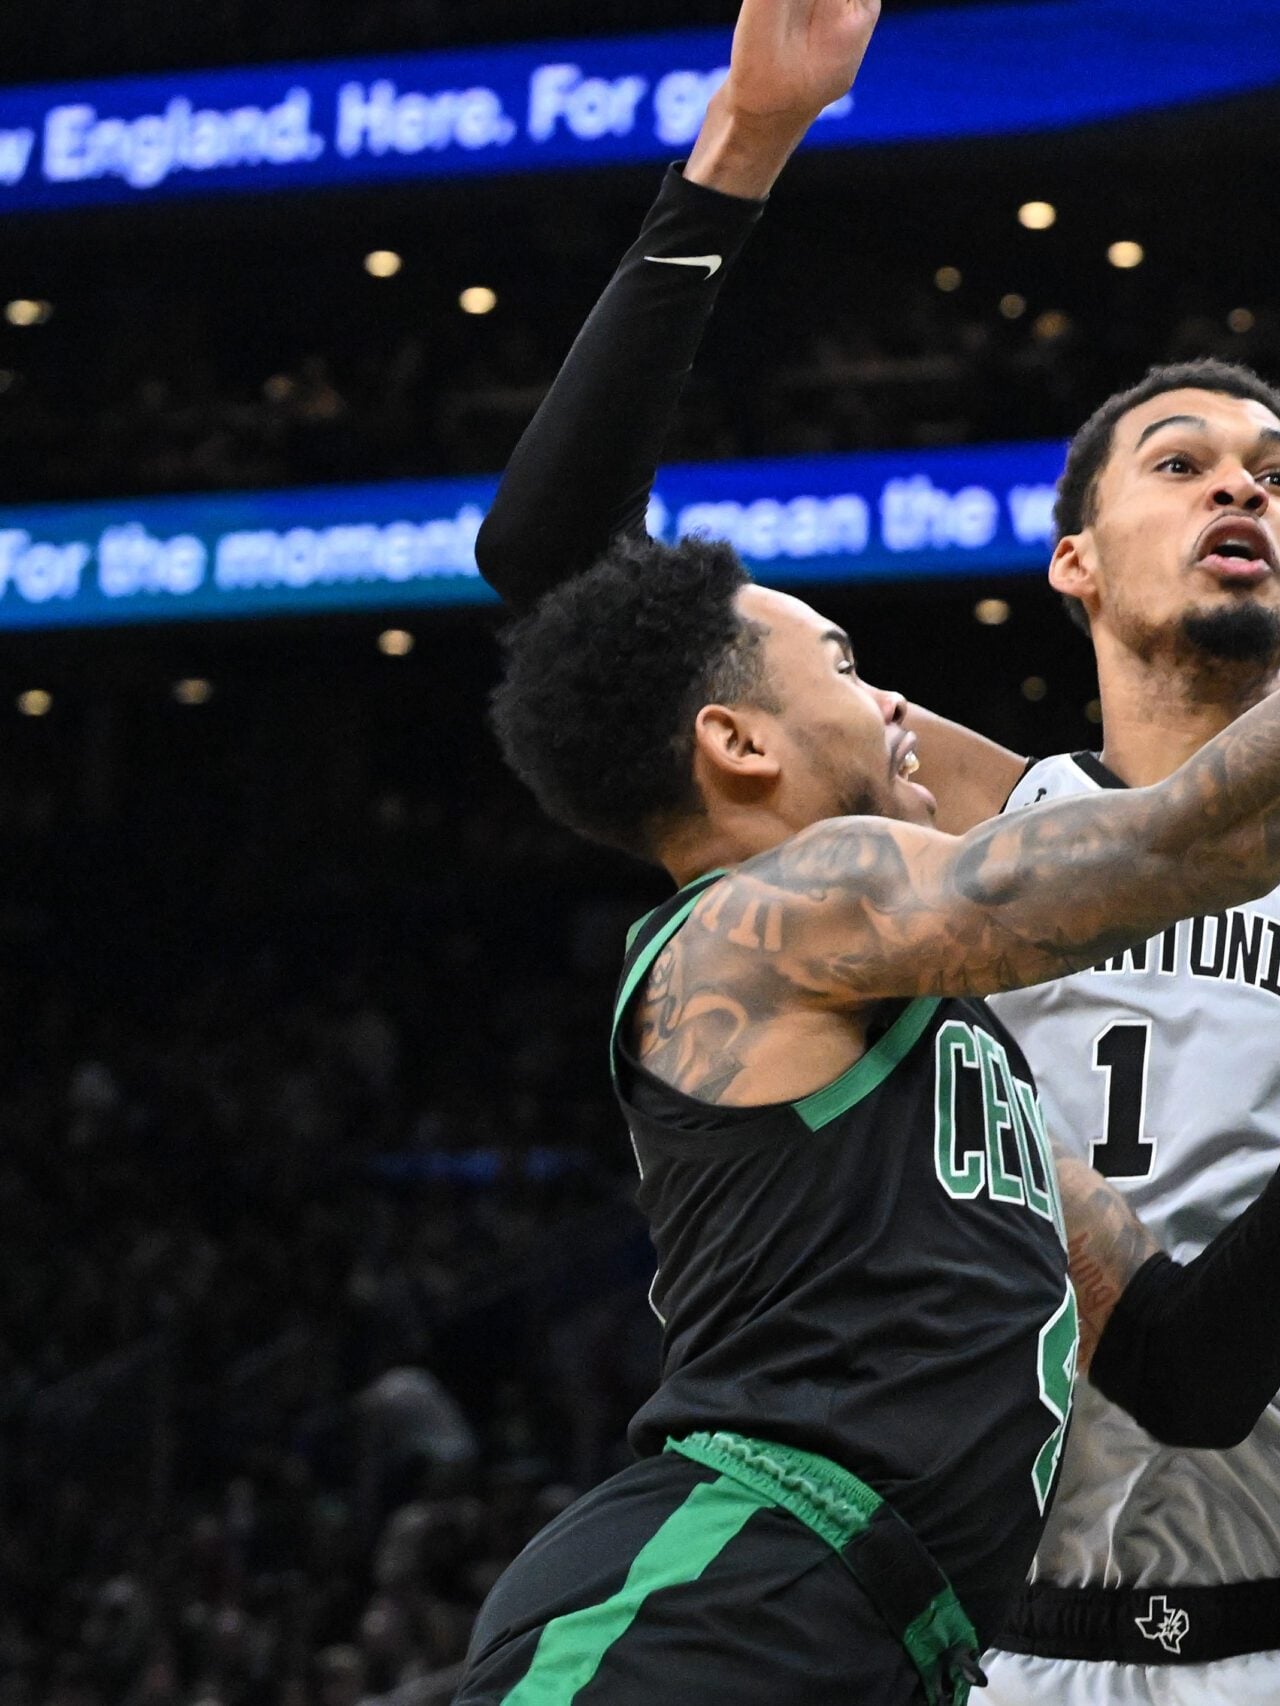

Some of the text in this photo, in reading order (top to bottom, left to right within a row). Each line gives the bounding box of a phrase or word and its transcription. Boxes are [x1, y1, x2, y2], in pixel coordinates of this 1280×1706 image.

[43, 88, 323, 187] England.
[339, 79, 514, 155] Here.
[529, 65, 645, 141] For
[98, 522, 208, 597] the
[216, 504, 484, 590] moment
[677, 495, 869, 560] mean
[880, 476, 997, 552] the
[1092, 1020, 1157, 1181] 1
